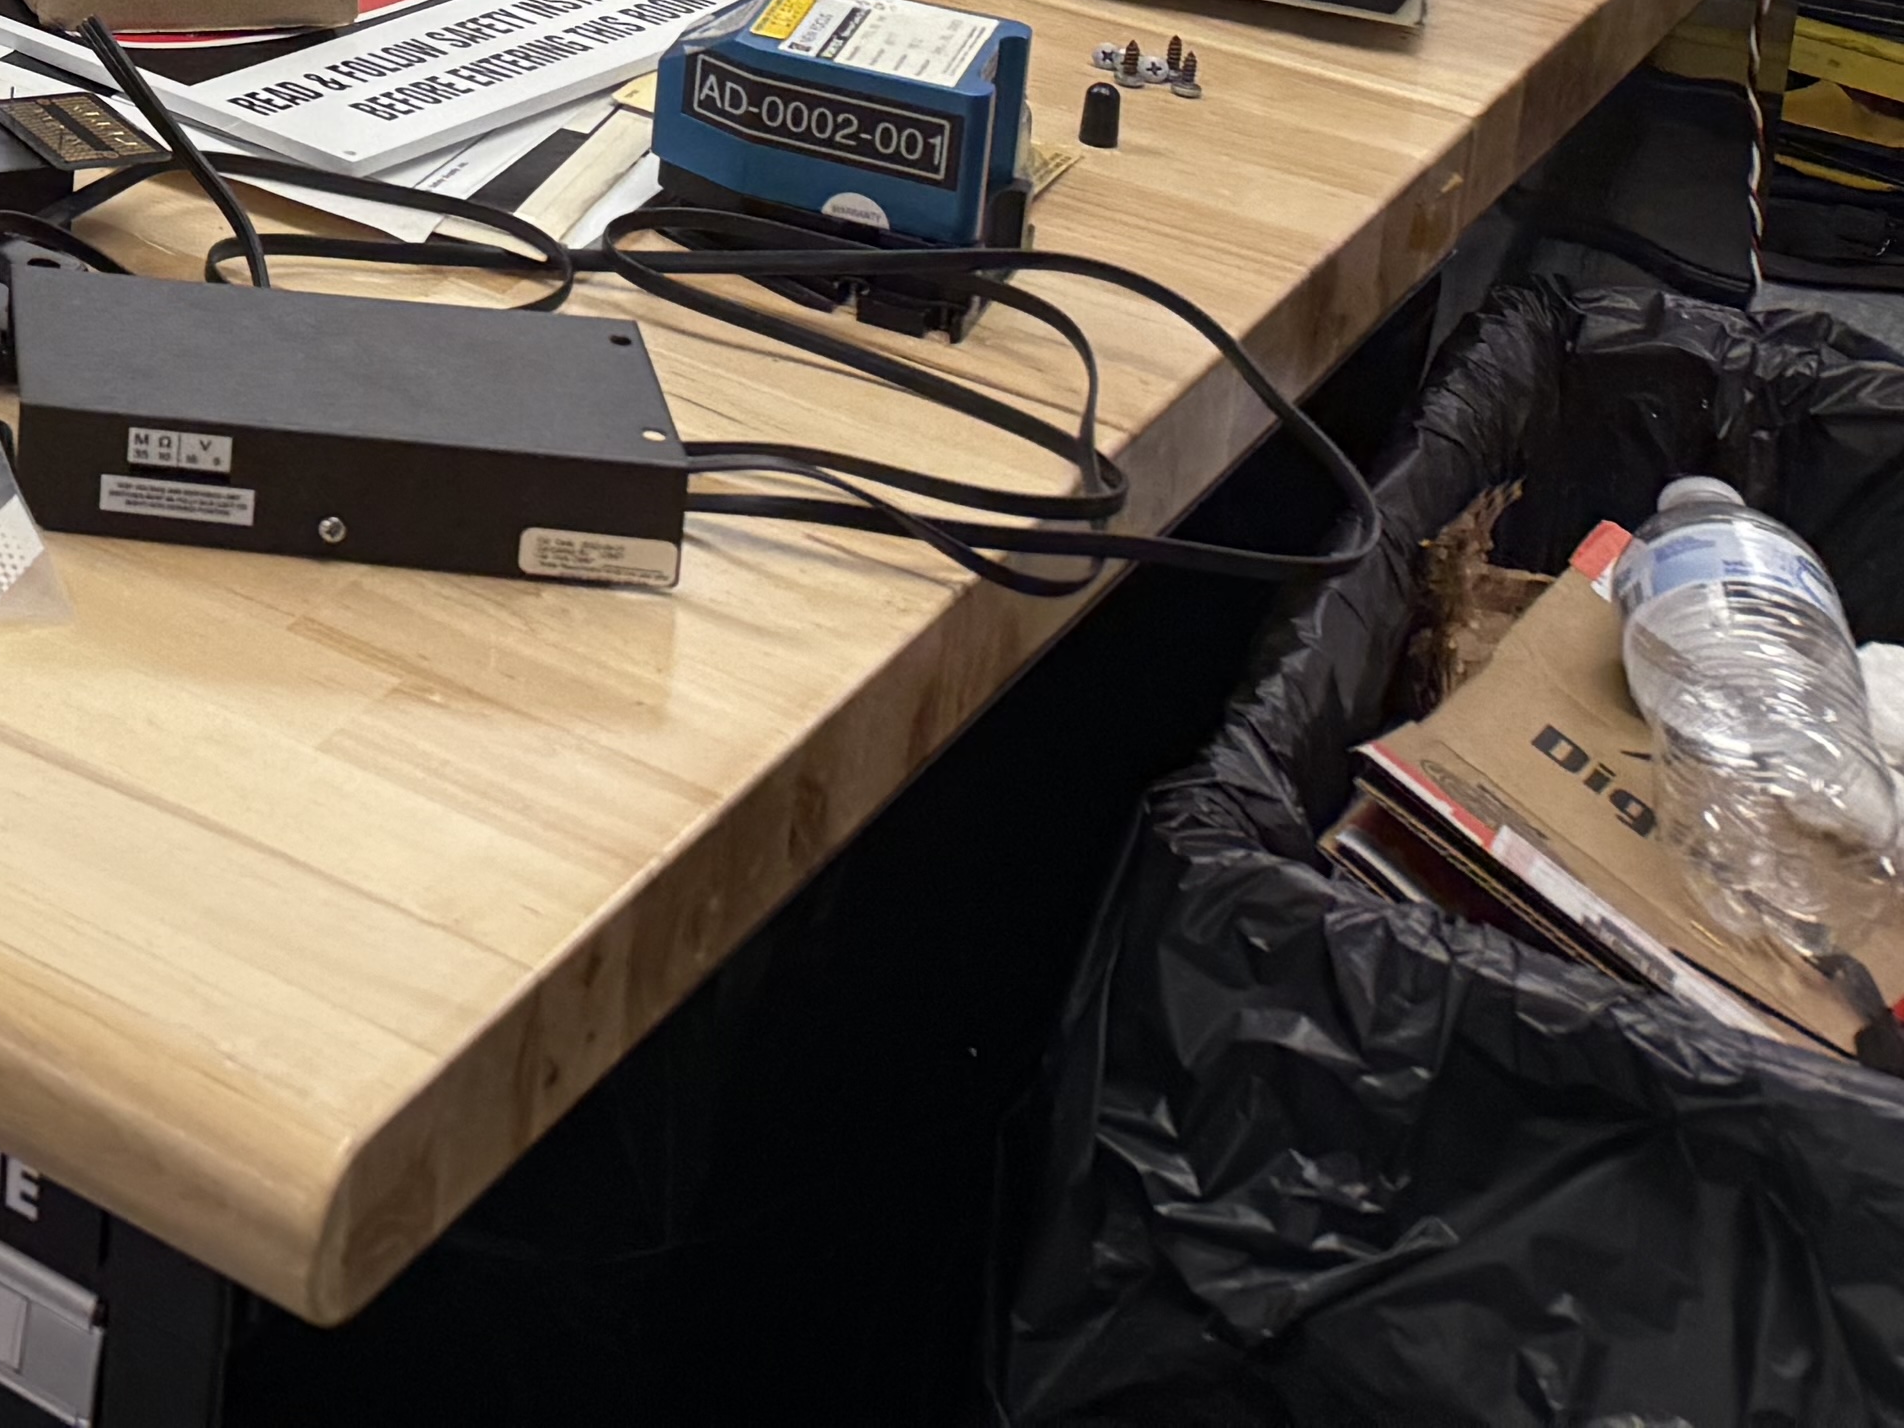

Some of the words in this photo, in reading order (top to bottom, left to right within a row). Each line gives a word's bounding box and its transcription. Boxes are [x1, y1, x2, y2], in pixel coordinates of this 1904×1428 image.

[226, 71, 308, 117] READ
[305, 71, 347, 93] &
[340, 32, 448, 85] FOLLOW
[347, 74, 477, 122] BEFORE
[459, 30, 583, 91] ENTERING
[564, 5, 643, 55] THIS
[698, 73, 944, 167] AD-0002-001
[199, 440, 212, 452] V
